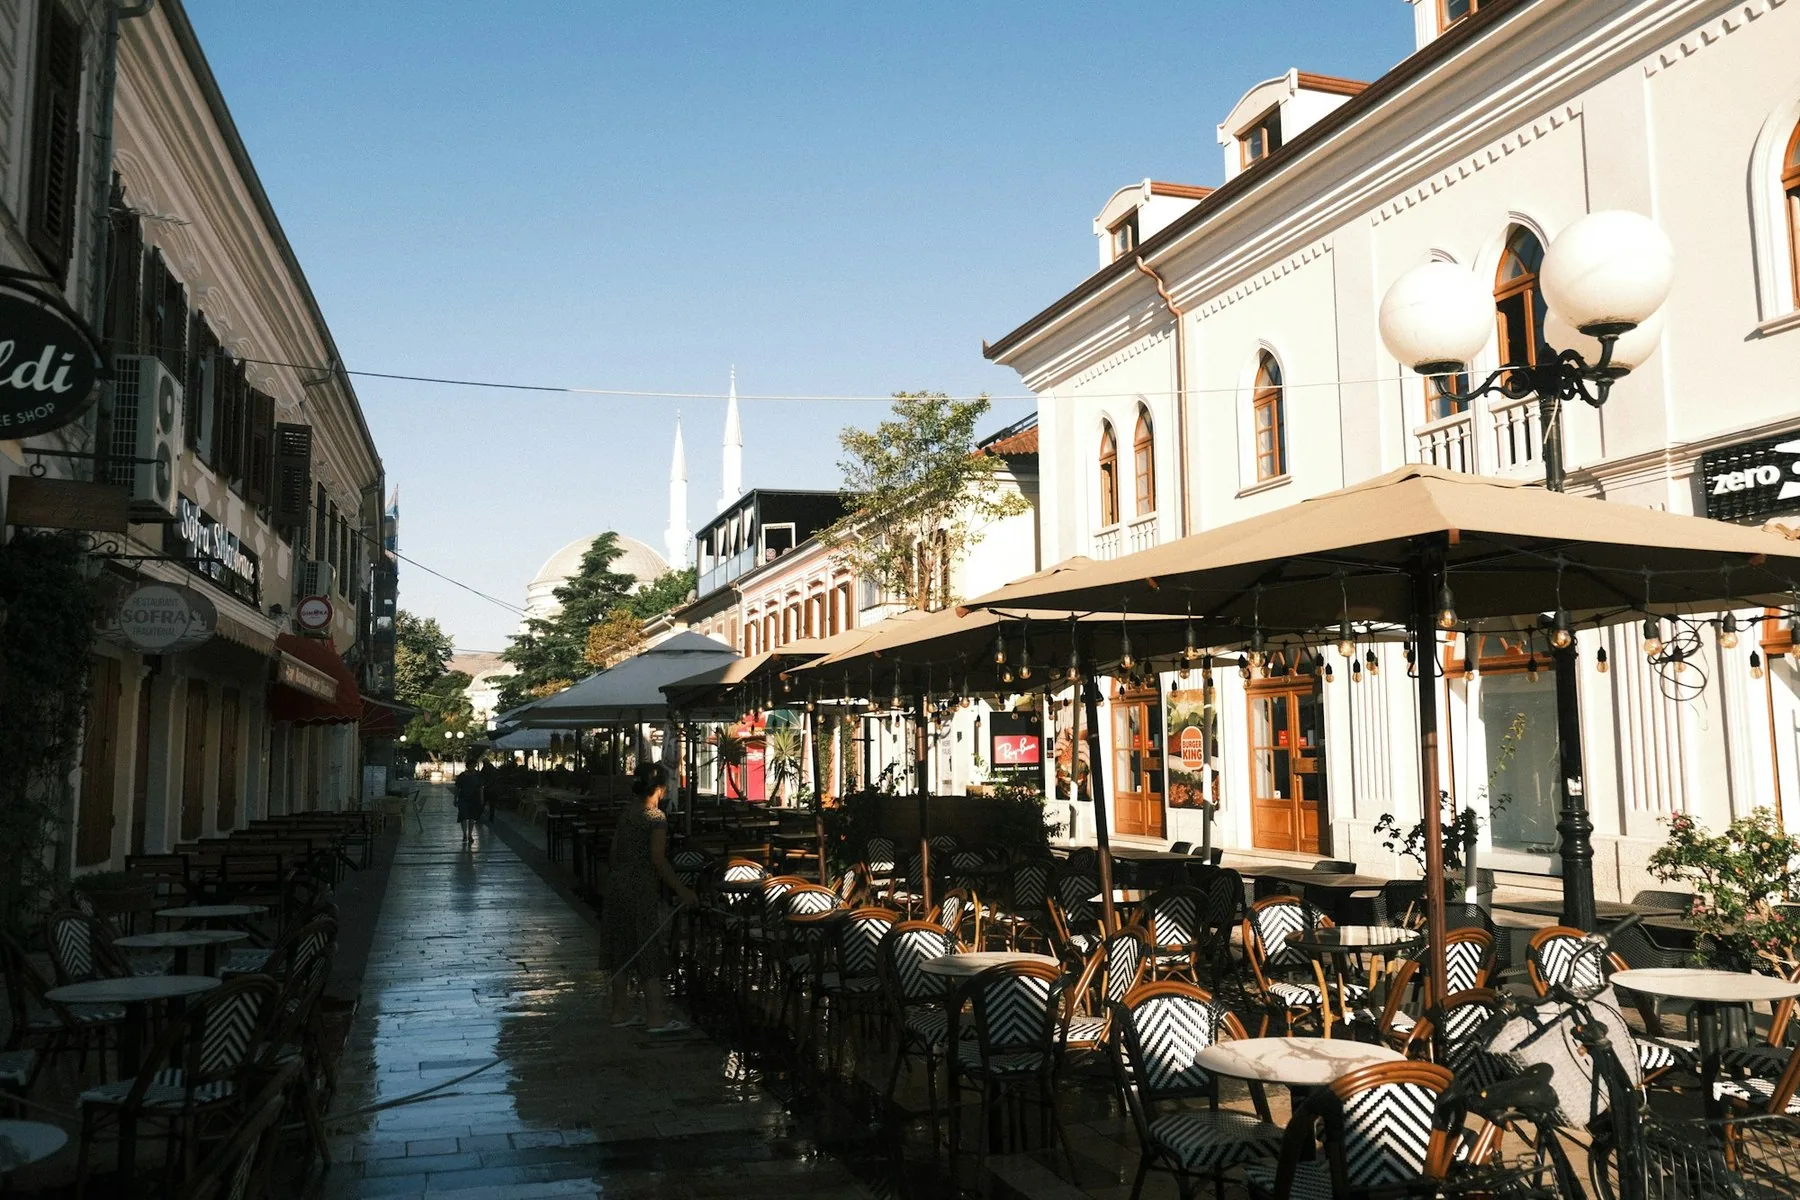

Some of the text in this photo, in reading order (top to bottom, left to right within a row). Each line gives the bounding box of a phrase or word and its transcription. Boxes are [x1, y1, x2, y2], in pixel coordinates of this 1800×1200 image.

[16, 402, 55, 424] SHOP
[1712, 465, 1780, 495] zero
[181, 498, 210, 559] Sofra
[122, 608, 187, 625] SOFRA
[997, 737, 1036, 760] Ray-Ban
[1182, 740, 1202, 749] BURGER
[1182, 749, 1203, 761] KING
